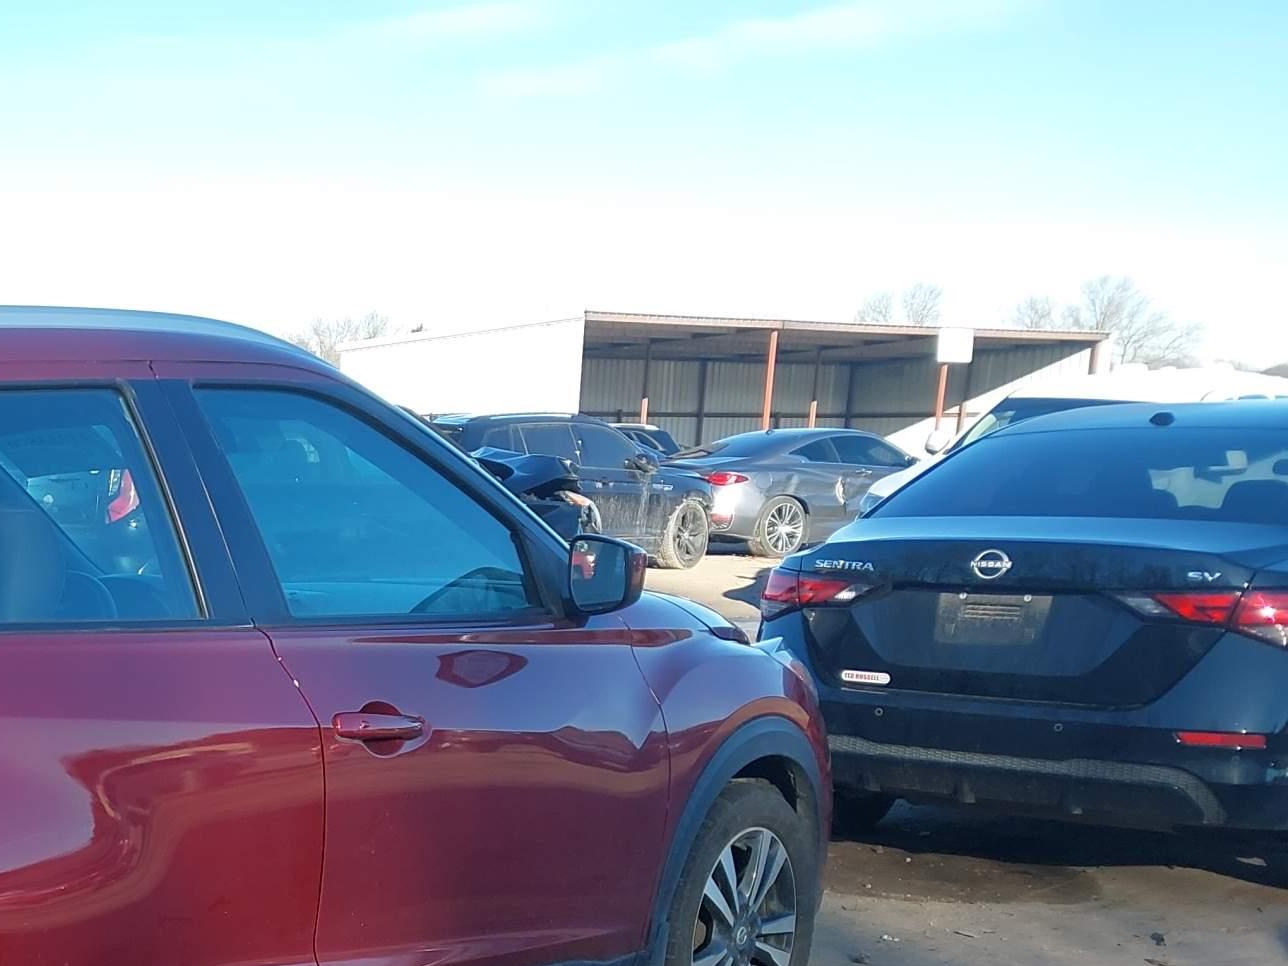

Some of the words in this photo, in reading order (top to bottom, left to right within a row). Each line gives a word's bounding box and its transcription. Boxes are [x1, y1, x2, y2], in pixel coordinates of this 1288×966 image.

[814, 559, 875, 571] SENTRA
[970, 560, 1013, 569] NISSAN
[1186, 571, 1222, 581] SV
